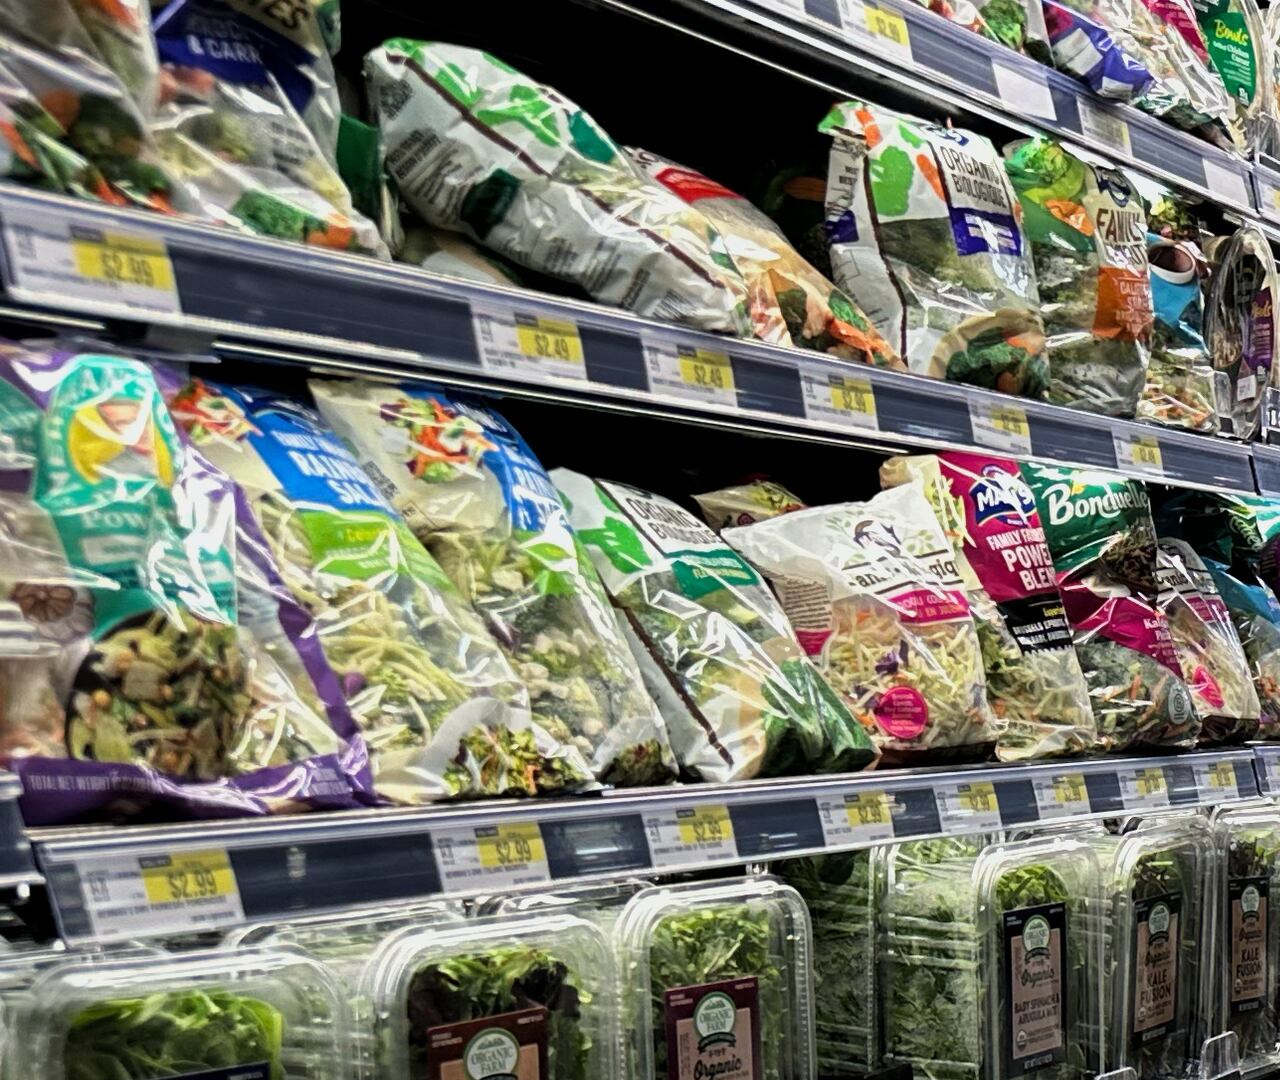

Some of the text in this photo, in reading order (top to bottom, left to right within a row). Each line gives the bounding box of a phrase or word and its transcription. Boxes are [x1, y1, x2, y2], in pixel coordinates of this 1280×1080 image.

[535, 333, 569, 361] $2.49
[694, 364, 723, 387] $2.49
[1040, 483, 1149, 526] Bonduelle
[986, 529, 1022, 551] FAMILY
[1001, 543, 1053, 573] POWE
[495, 836, 532, 865] $2.99
[167, 866, 218, 899] $2.99
[471, 1045, 514, 1066] ORGANIC
[480, 1058, 507, 1076] FARM
